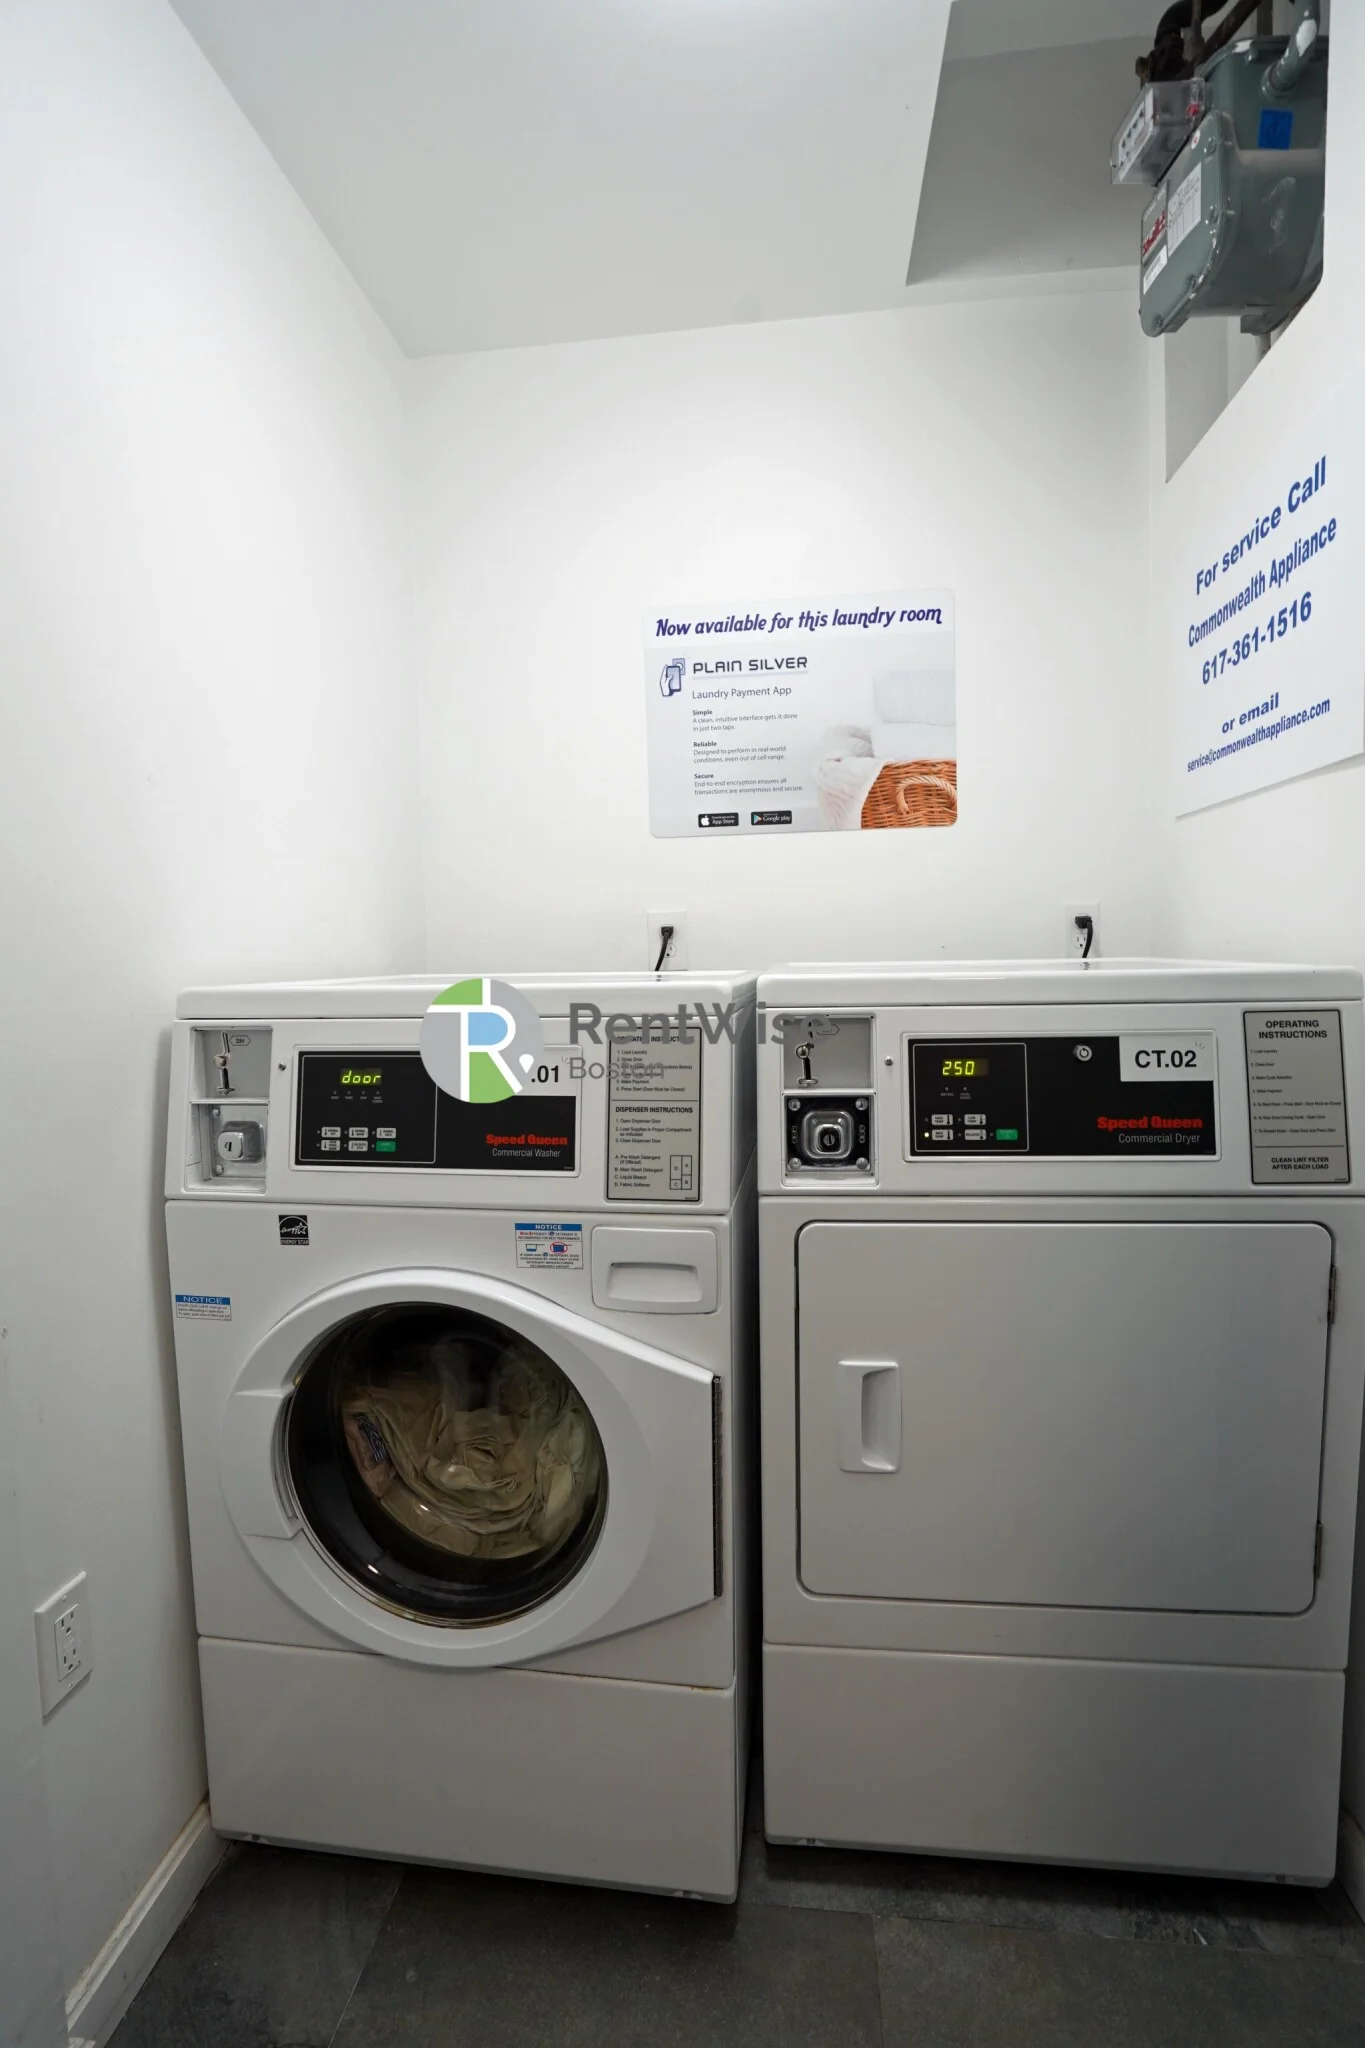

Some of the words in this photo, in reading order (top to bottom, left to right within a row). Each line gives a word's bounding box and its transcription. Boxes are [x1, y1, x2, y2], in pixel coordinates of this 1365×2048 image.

[1196, 561, 1219, 596] For
[1222, 506, 1281, 573] service
[1287, 454, 1326, 513] Call
[1188, 570, 1265, 647] Commonwealth
[1269, 517, 1337, 589] Appliance
[656, 618, 692, 637] Now
[695, 614, 767, 634] available
[768, 612, 794, 633] for
[798, 610, 828, 632] this
[831, 606, 897, 629] laundry
[899, 608, 942, 624] room
[1202, 591, 1312, 685] 617-361-1516
[693, 660, 742, 674] PLAIN
[748, 657, 808, 671] SILVER
[692, 689, 729, 700] Laundry
[731, 688, 770, 699] Payment
[772, 686, 792, 696] App
[692, 709, 713, 717] Simple
[1221, 717, 1236, 734] or
[1239, 692, 1280, 726] email
[1187, 698, 1330, 773] service@commonwealthappliance.com
[727, 747, 751, 755] perform
[1265, 1020, 1319, 1028] OPERATING
[1259, 1030, 1328, 1039] INSTRUCTIONS
[1134, 1050, 1197, 1069] CT.02
[531, 1065, 559, 1083] .01
[942, 1061, 975, 1076] 250
[342, 1069, 381, 1084] door
[1096, 1116, 1149, 1131] Speed
[1151, 1116, 1203, 1129] Queen
[486, 1134, 526, 1146] Speed
[527, 1134, 569, 1145] Queen
[1118, 1133, 1172, 1144] Commercial
[1176, 1133, 1200, 1145] Dryer
[492, 1148, 533, 1157] Commercial
[534, 1148, 561, 1158] Washer
[183, 1296, 223, 1304] NOTICE
